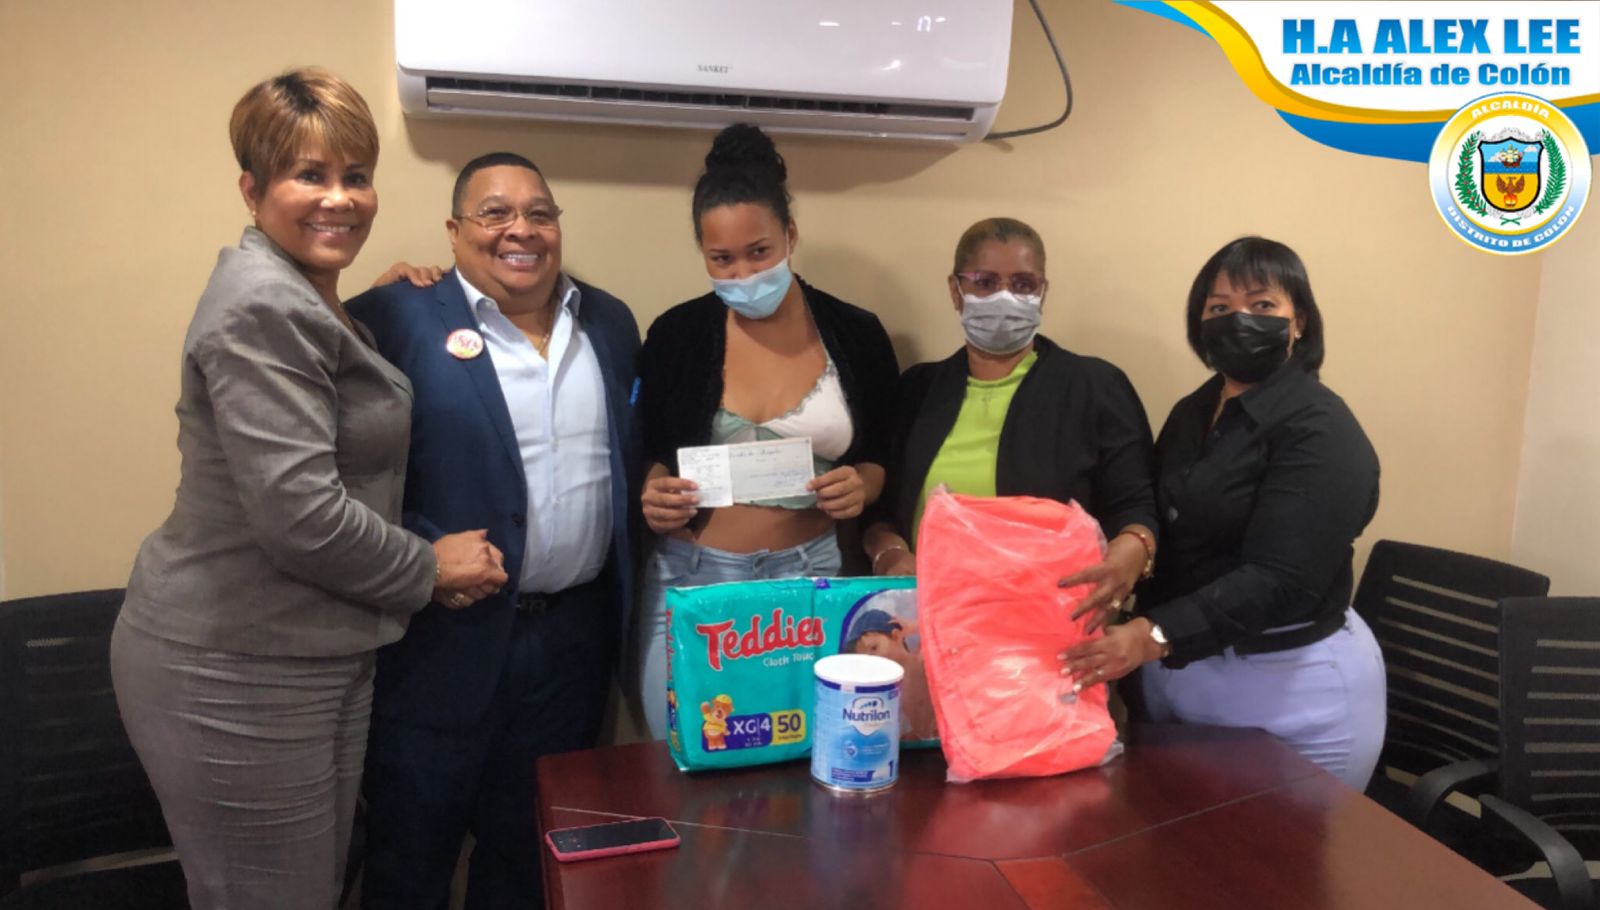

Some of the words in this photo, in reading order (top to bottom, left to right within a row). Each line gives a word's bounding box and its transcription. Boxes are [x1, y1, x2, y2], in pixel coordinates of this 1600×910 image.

[696, 608, 825, 671] Teddies
[763, 655, 790, 667] Cloth
[792, 652, 815, 662] Touc
[842, 708, 891, 721] Nutrilon
[777, 713, 802, 734] 50
[888, 760, 894, 777] 1
